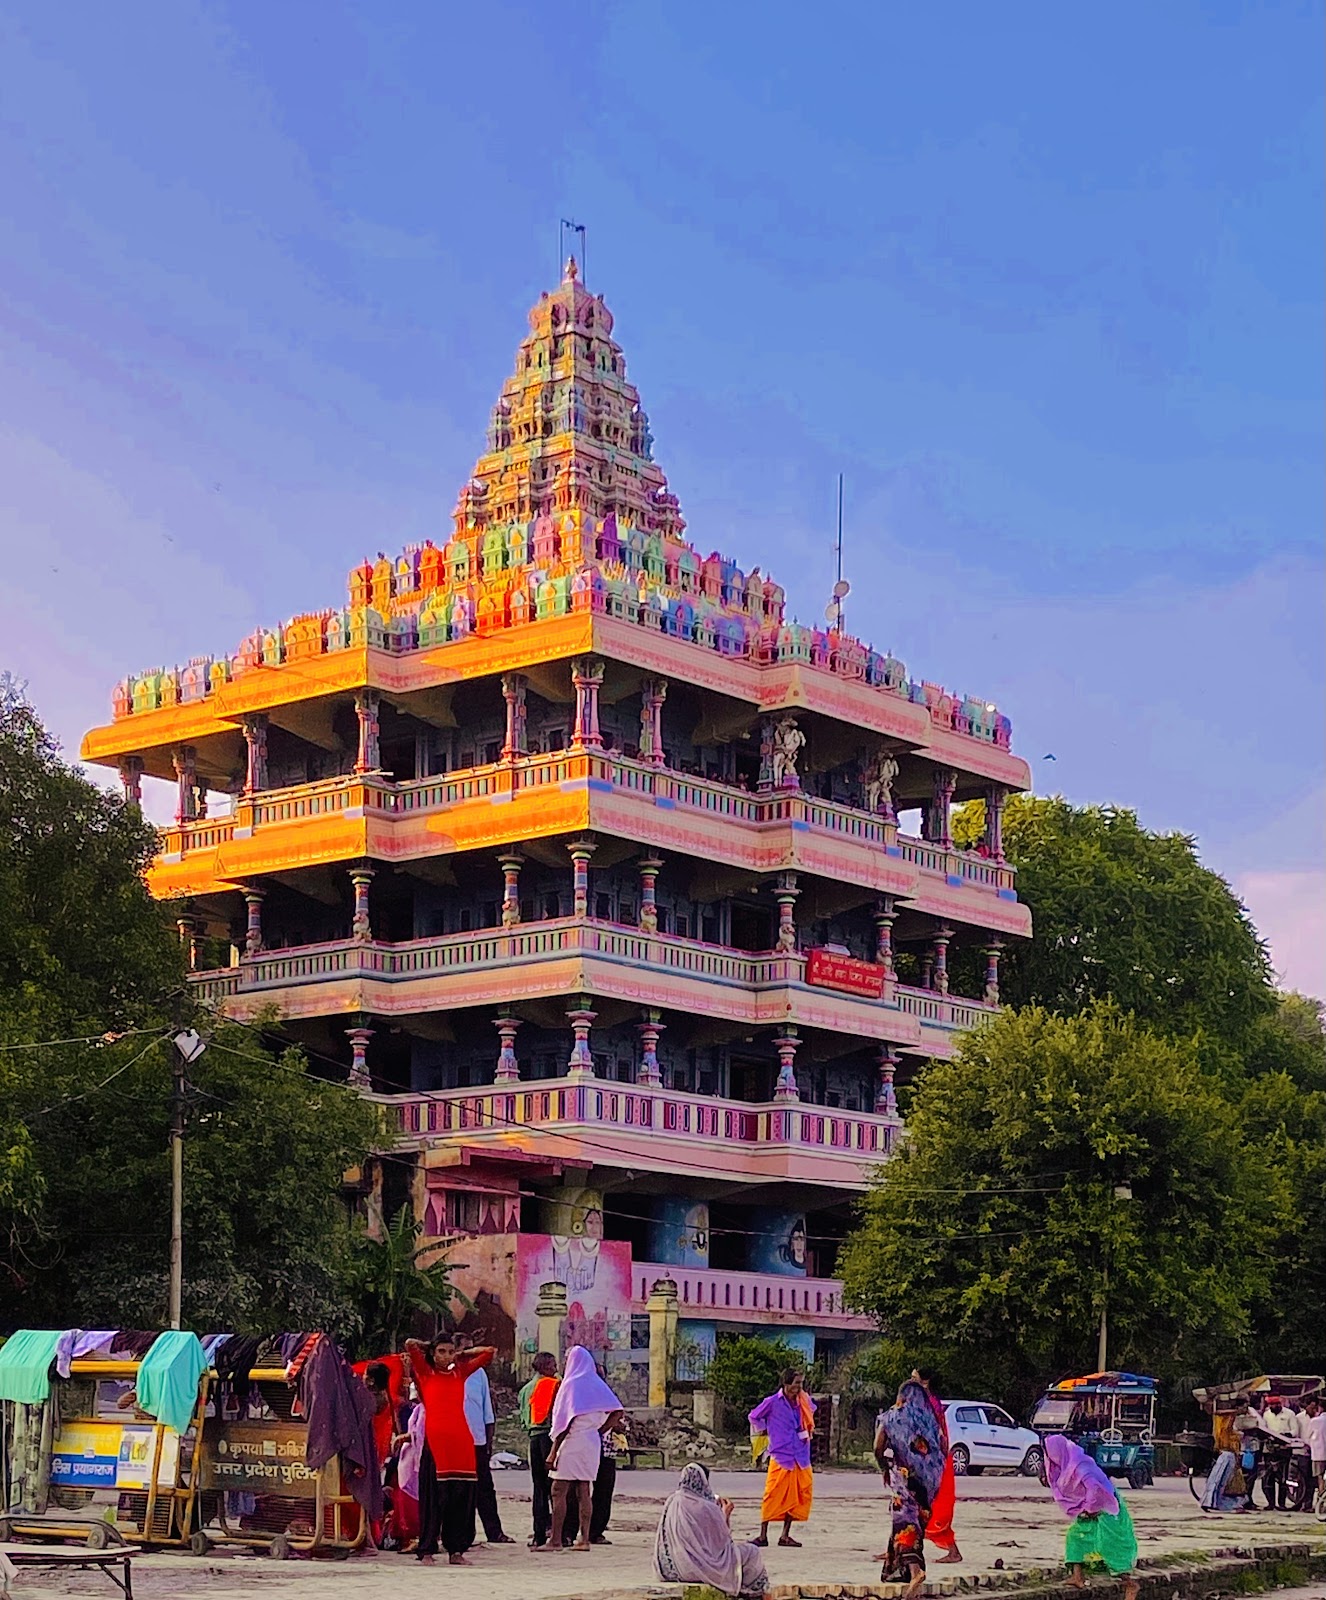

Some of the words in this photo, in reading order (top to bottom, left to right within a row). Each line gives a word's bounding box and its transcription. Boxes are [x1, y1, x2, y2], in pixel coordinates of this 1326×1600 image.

[229, 1442, 263, 1459] कृपया
[50, 1459, 72, 1476] लिस
[73, 1463, 115, 1477] प्रयागराज
[213, 1462, 243, 1475] उत्तर
[245, 1460, 279, 1478] प्रदेश
